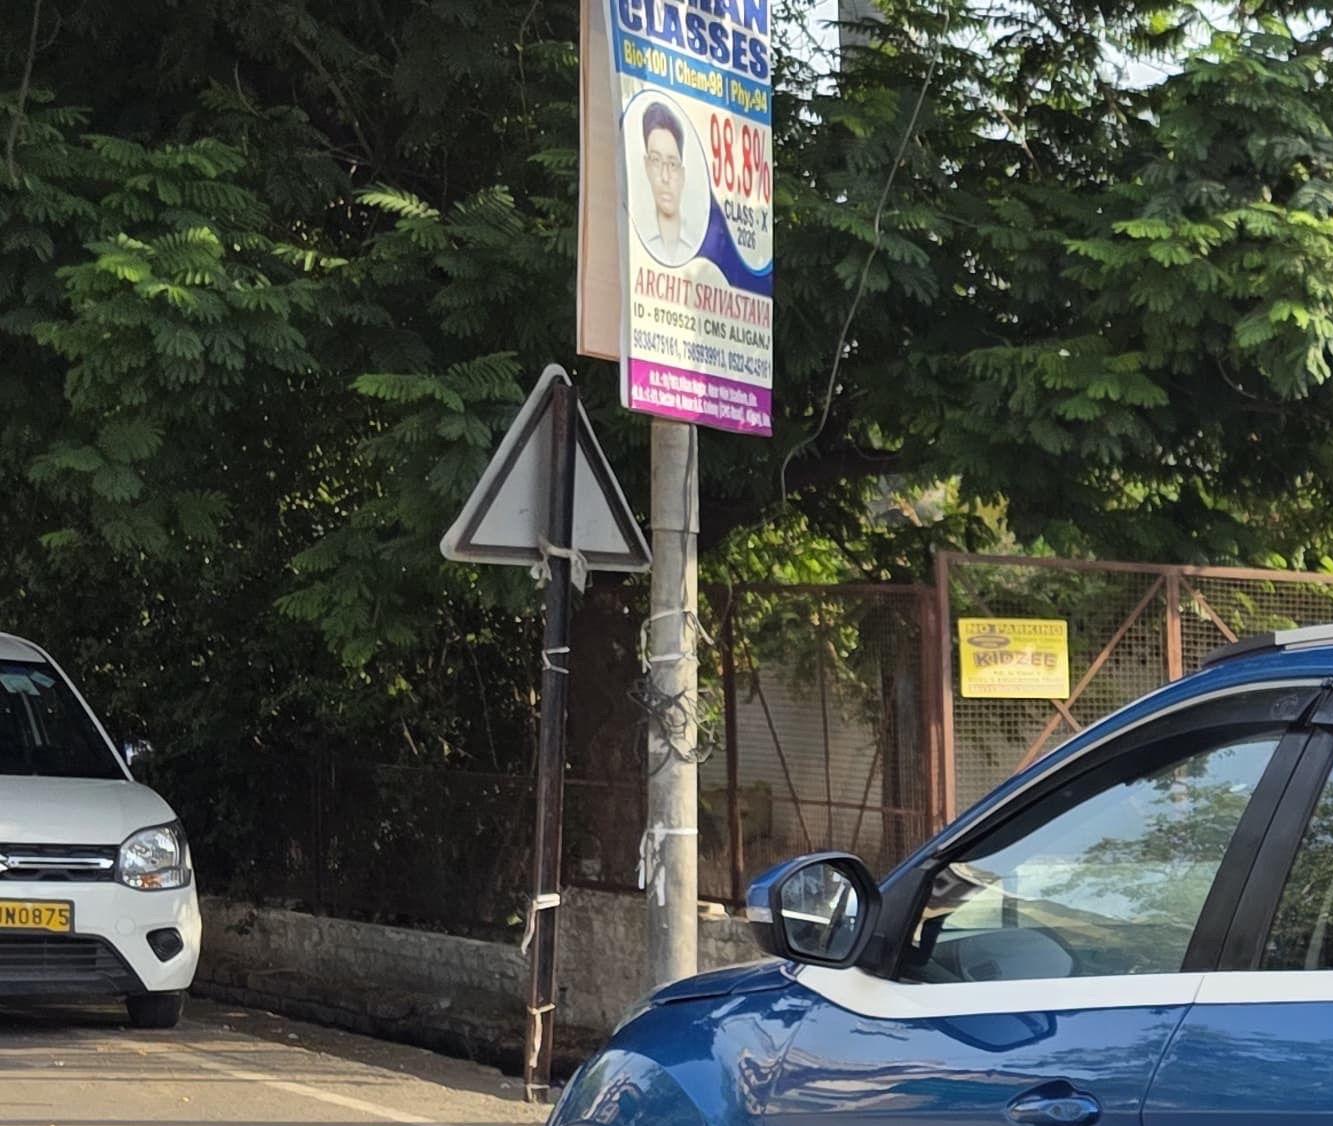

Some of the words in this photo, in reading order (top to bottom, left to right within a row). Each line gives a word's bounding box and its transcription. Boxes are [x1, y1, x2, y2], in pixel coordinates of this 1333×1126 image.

[619, 0, 769, 79] CLASSES
[624, 40, 667, 77] Bio-100
[711, 113, 770, 204] 98.8%
[724, 199, 754, 228] CLASS
[634, 267, 692, 306] ARCHIT
[694, 283, 770, 328] SRIVASTAVA
[634, 302, 645, 318] ID
[654, 307, 696, 331] 8709522
[704, 319, 726, 340] CMS
[729, 326, 770, 350] ALIGANJ
[974, 651, 1058, 669] KIDZEE
[0, 906, 69, 926] N0875
